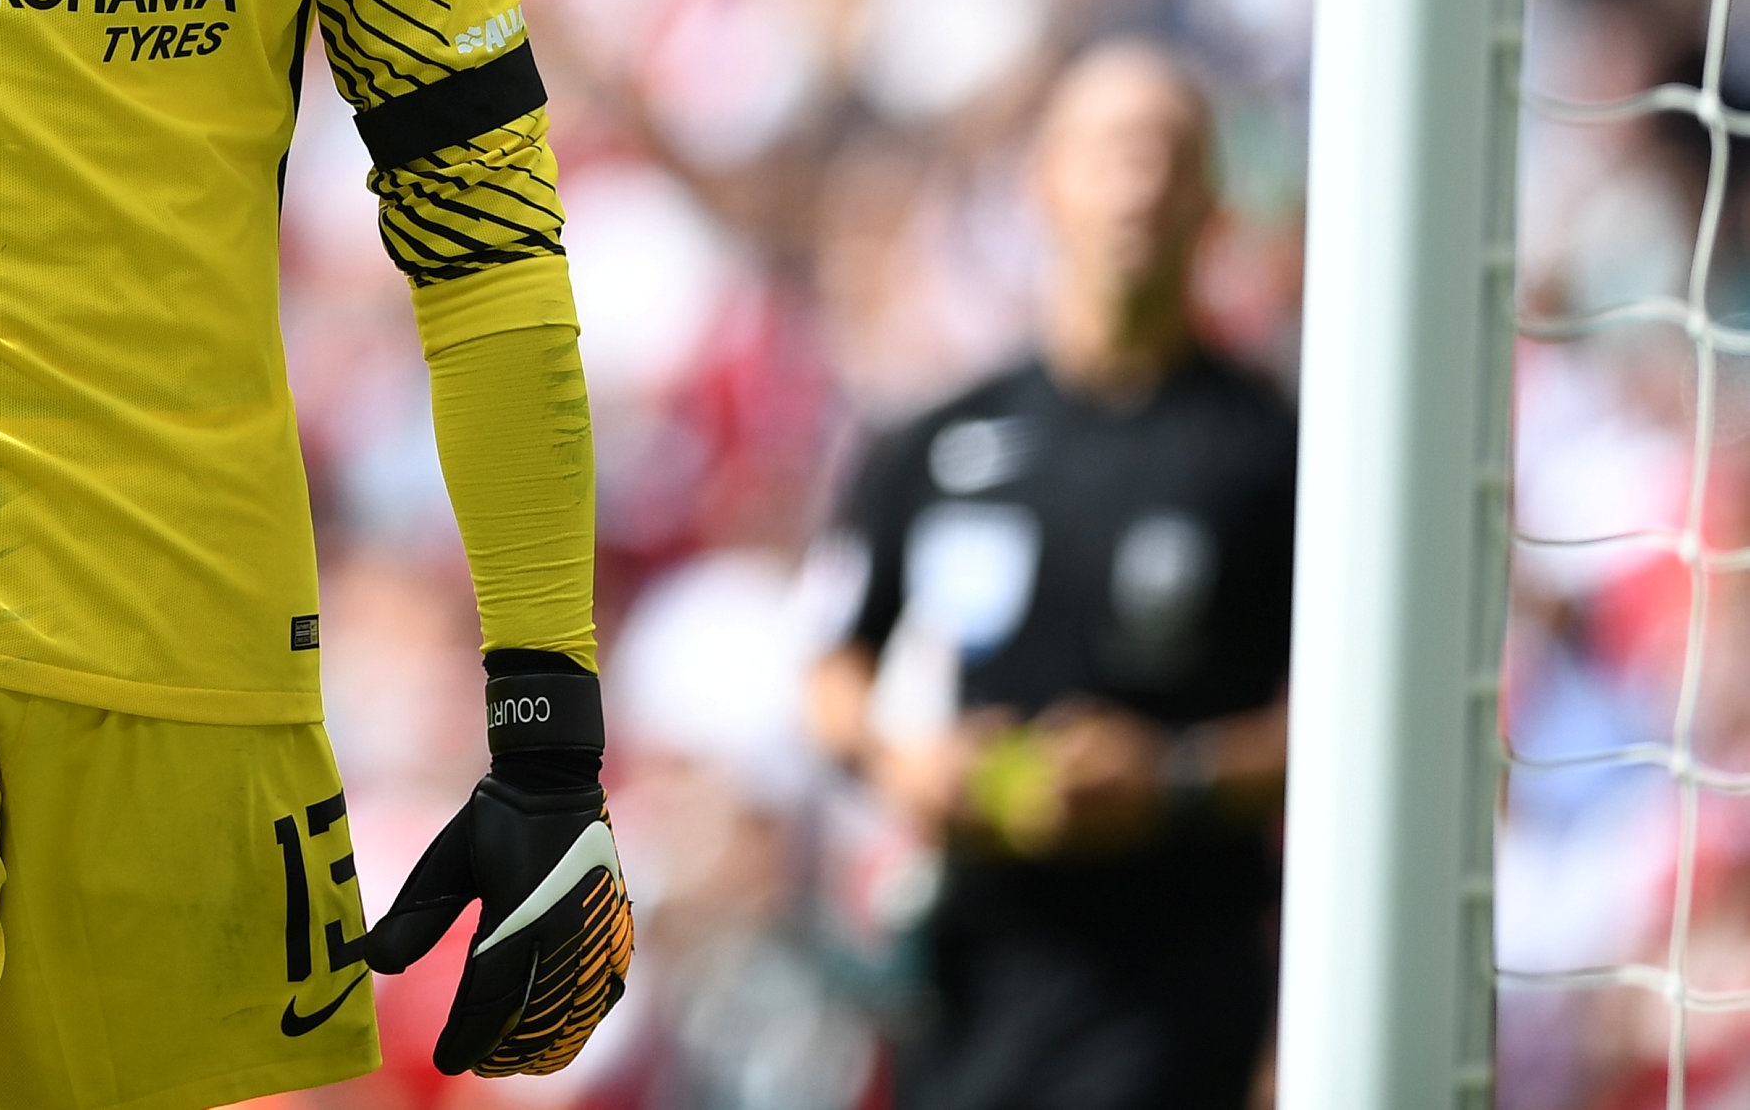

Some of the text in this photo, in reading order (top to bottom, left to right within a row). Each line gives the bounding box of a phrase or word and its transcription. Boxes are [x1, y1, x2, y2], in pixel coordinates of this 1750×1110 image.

[102, 22, 230, 62] TYRES
[486, 696, 550, 728] COURT
[274, 788, 367, 983] 13
